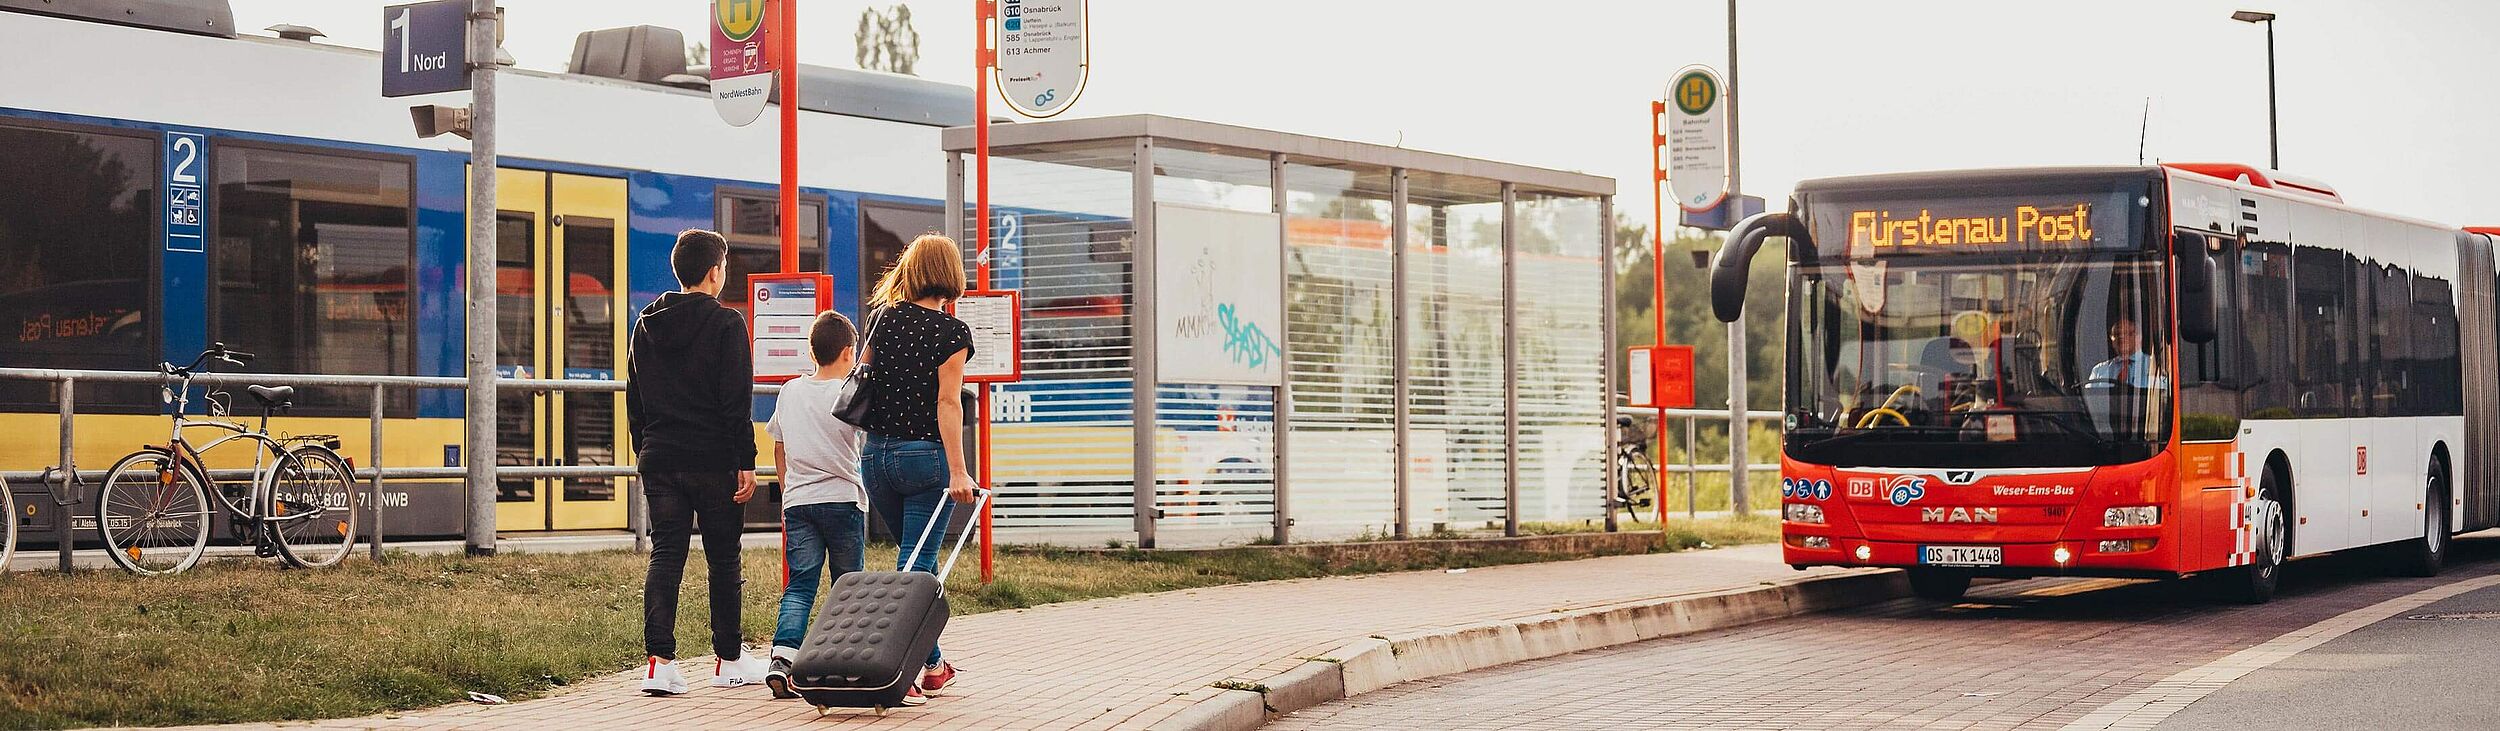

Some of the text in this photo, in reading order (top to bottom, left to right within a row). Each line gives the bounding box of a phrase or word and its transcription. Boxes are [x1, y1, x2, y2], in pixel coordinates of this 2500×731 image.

[1005, 5, 1062, 16] 610 Osnabrück
[391, 8, 446, 73] 1 Nord
[1006, 34, 1021, 42] 585
[1006, 47, 1021, 56] 613
[719, 86, 762, 100] NordWestBahn
[1035, 89, 1055, 106] OS
[1687, 80, 1704, 106] H
[173, 137, 196, 183] 2
[1001, 214, 1018, 250] 2
[1852, 204, 2092, 247] Fürstenau Post
[1850, 481, 1872, 496] DB
[1993, 485, 2074, 496] Weser-Ems-Bus
[1922, 507, 1998, 523] MAN
[1927, 549, 2001, 563] OS TK 1448
